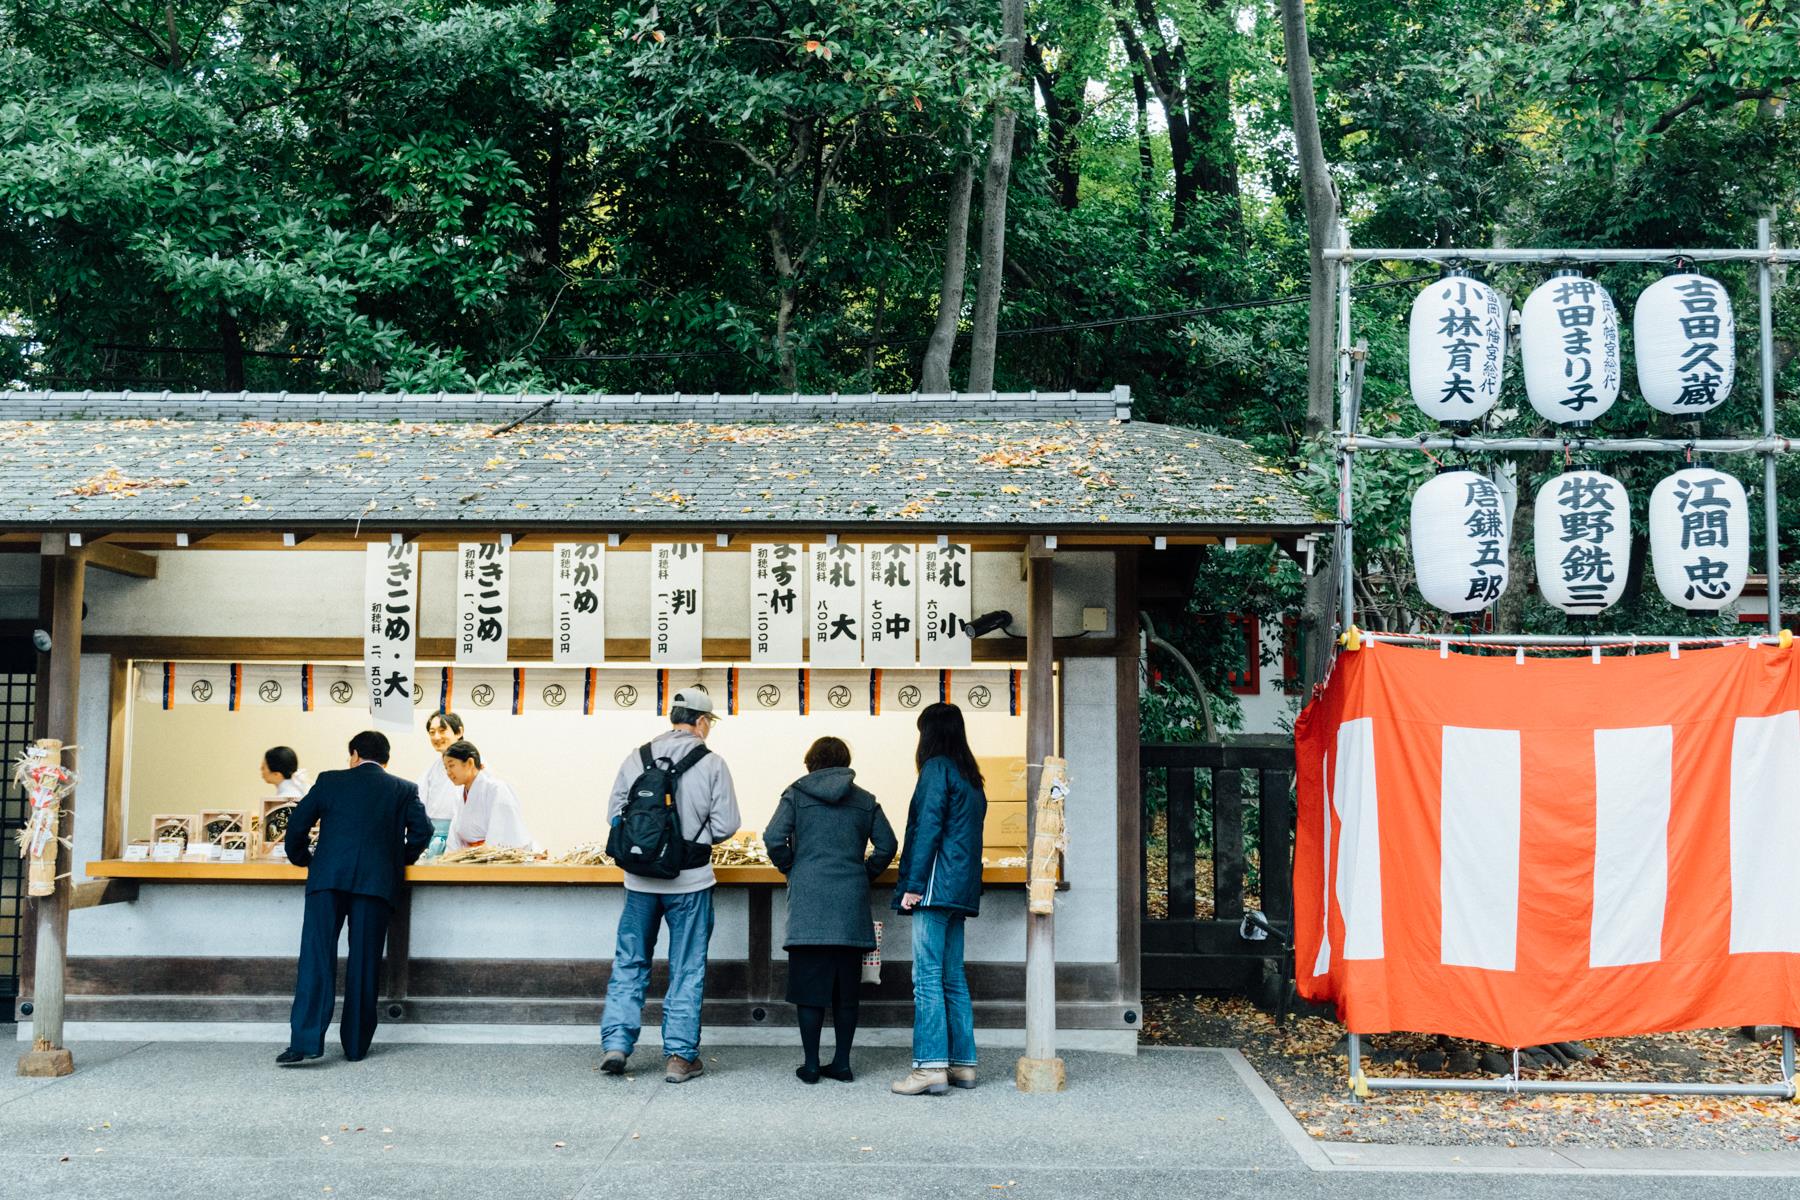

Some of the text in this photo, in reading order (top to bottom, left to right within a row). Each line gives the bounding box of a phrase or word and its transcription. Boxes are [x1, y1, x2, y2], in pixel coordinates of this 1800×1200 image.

[1437, 281, 1484, 404] 小林育夫
[1552, 281, 1599, 412] 押田まり子
[1673, 279, 1725, 406] 吉田久蔵
[1463, 478, 1506, 602] 唐鎌五郎
[1557, 476, 1616, 607] 牧野銑三
[1672, 477, 1732, 602] 江間忠
